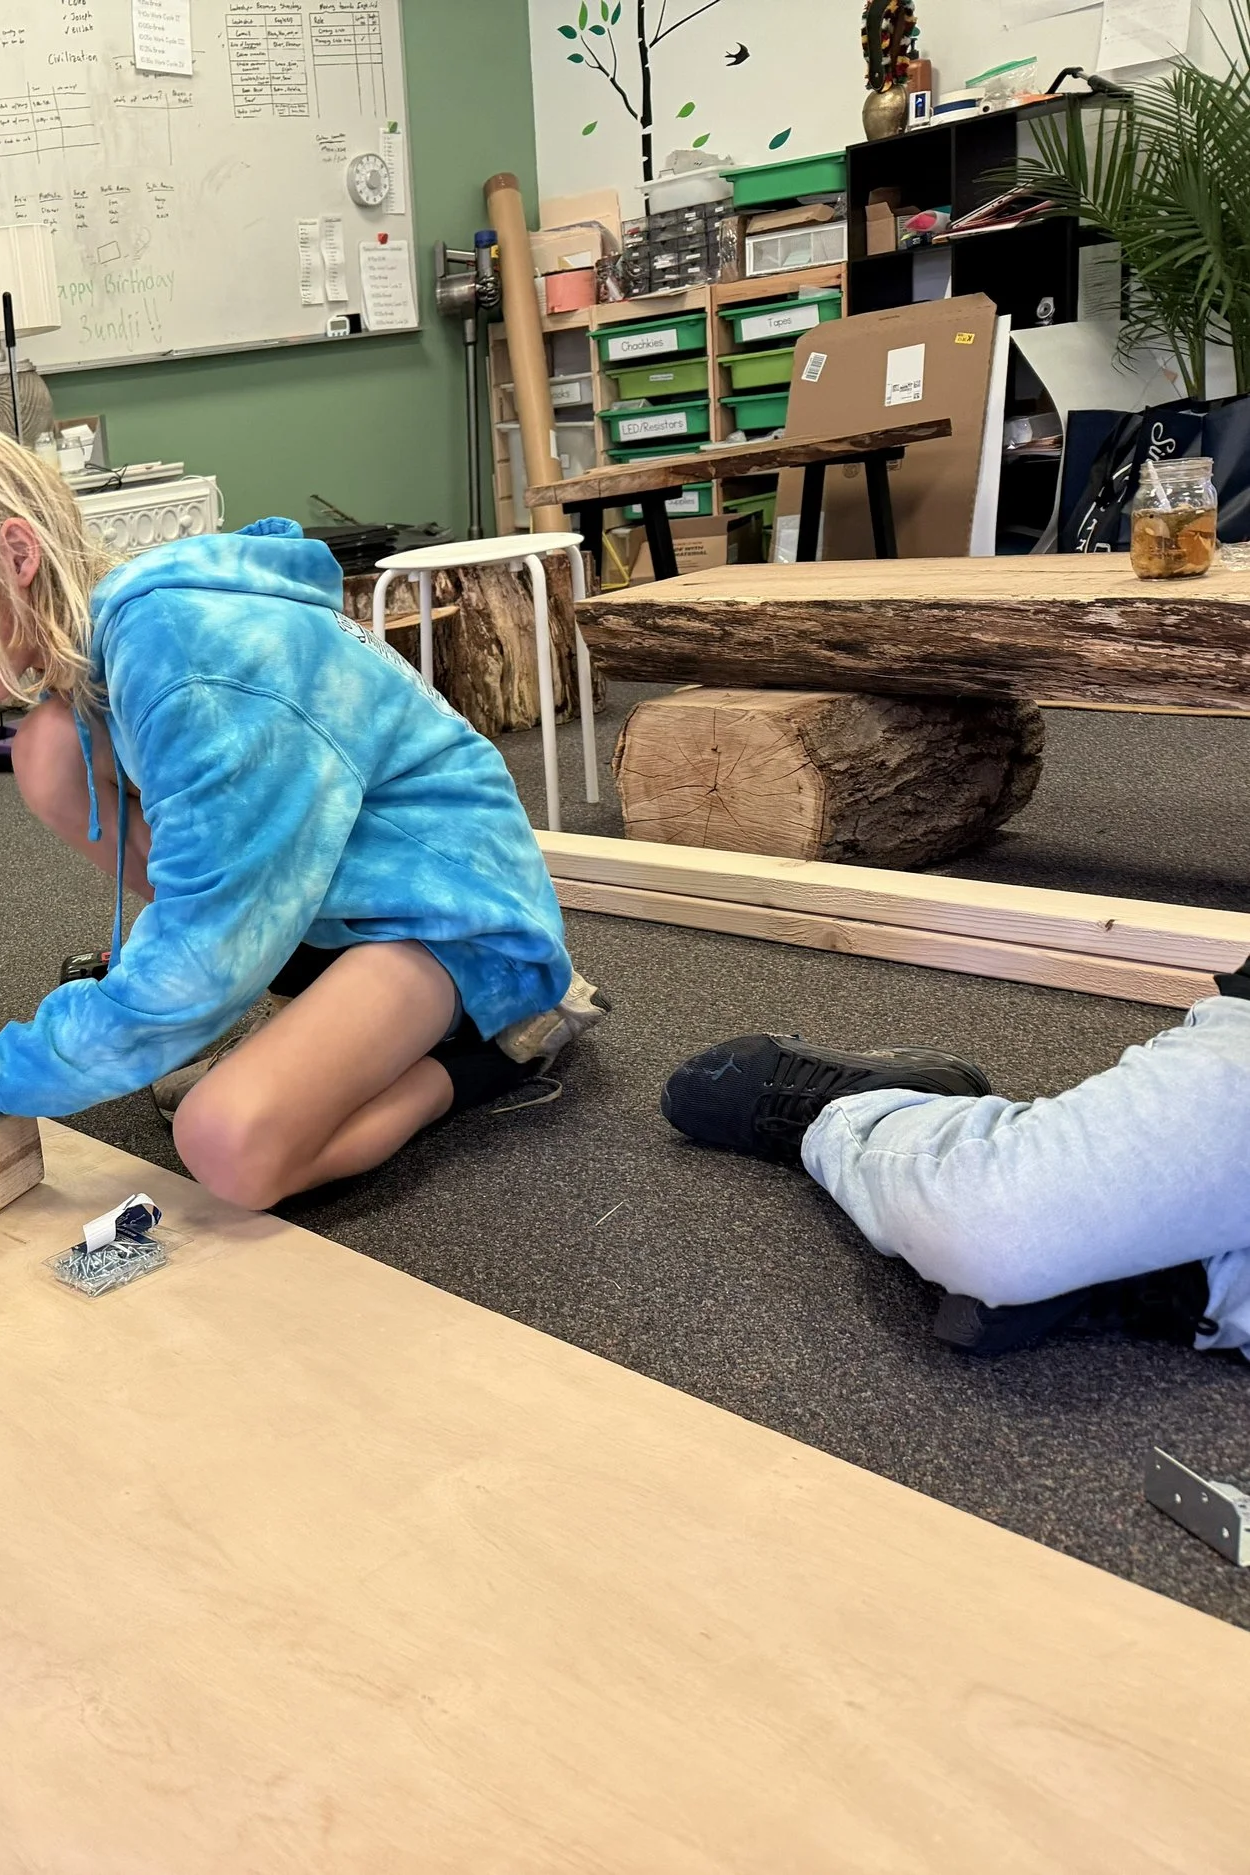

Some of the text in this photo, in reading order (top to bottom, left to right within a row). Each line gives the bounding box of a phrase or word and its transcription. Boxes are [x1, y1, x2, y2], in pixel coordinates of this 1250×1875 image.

[48, 50, 98, 65] Civilization
[57, 268, 174, 307] appy Birthday
[767, 316, 792, 328] Tapes
[621, 338, 664, 352] Chachkies
[621, 418, 685, 436] LED/Resistors
